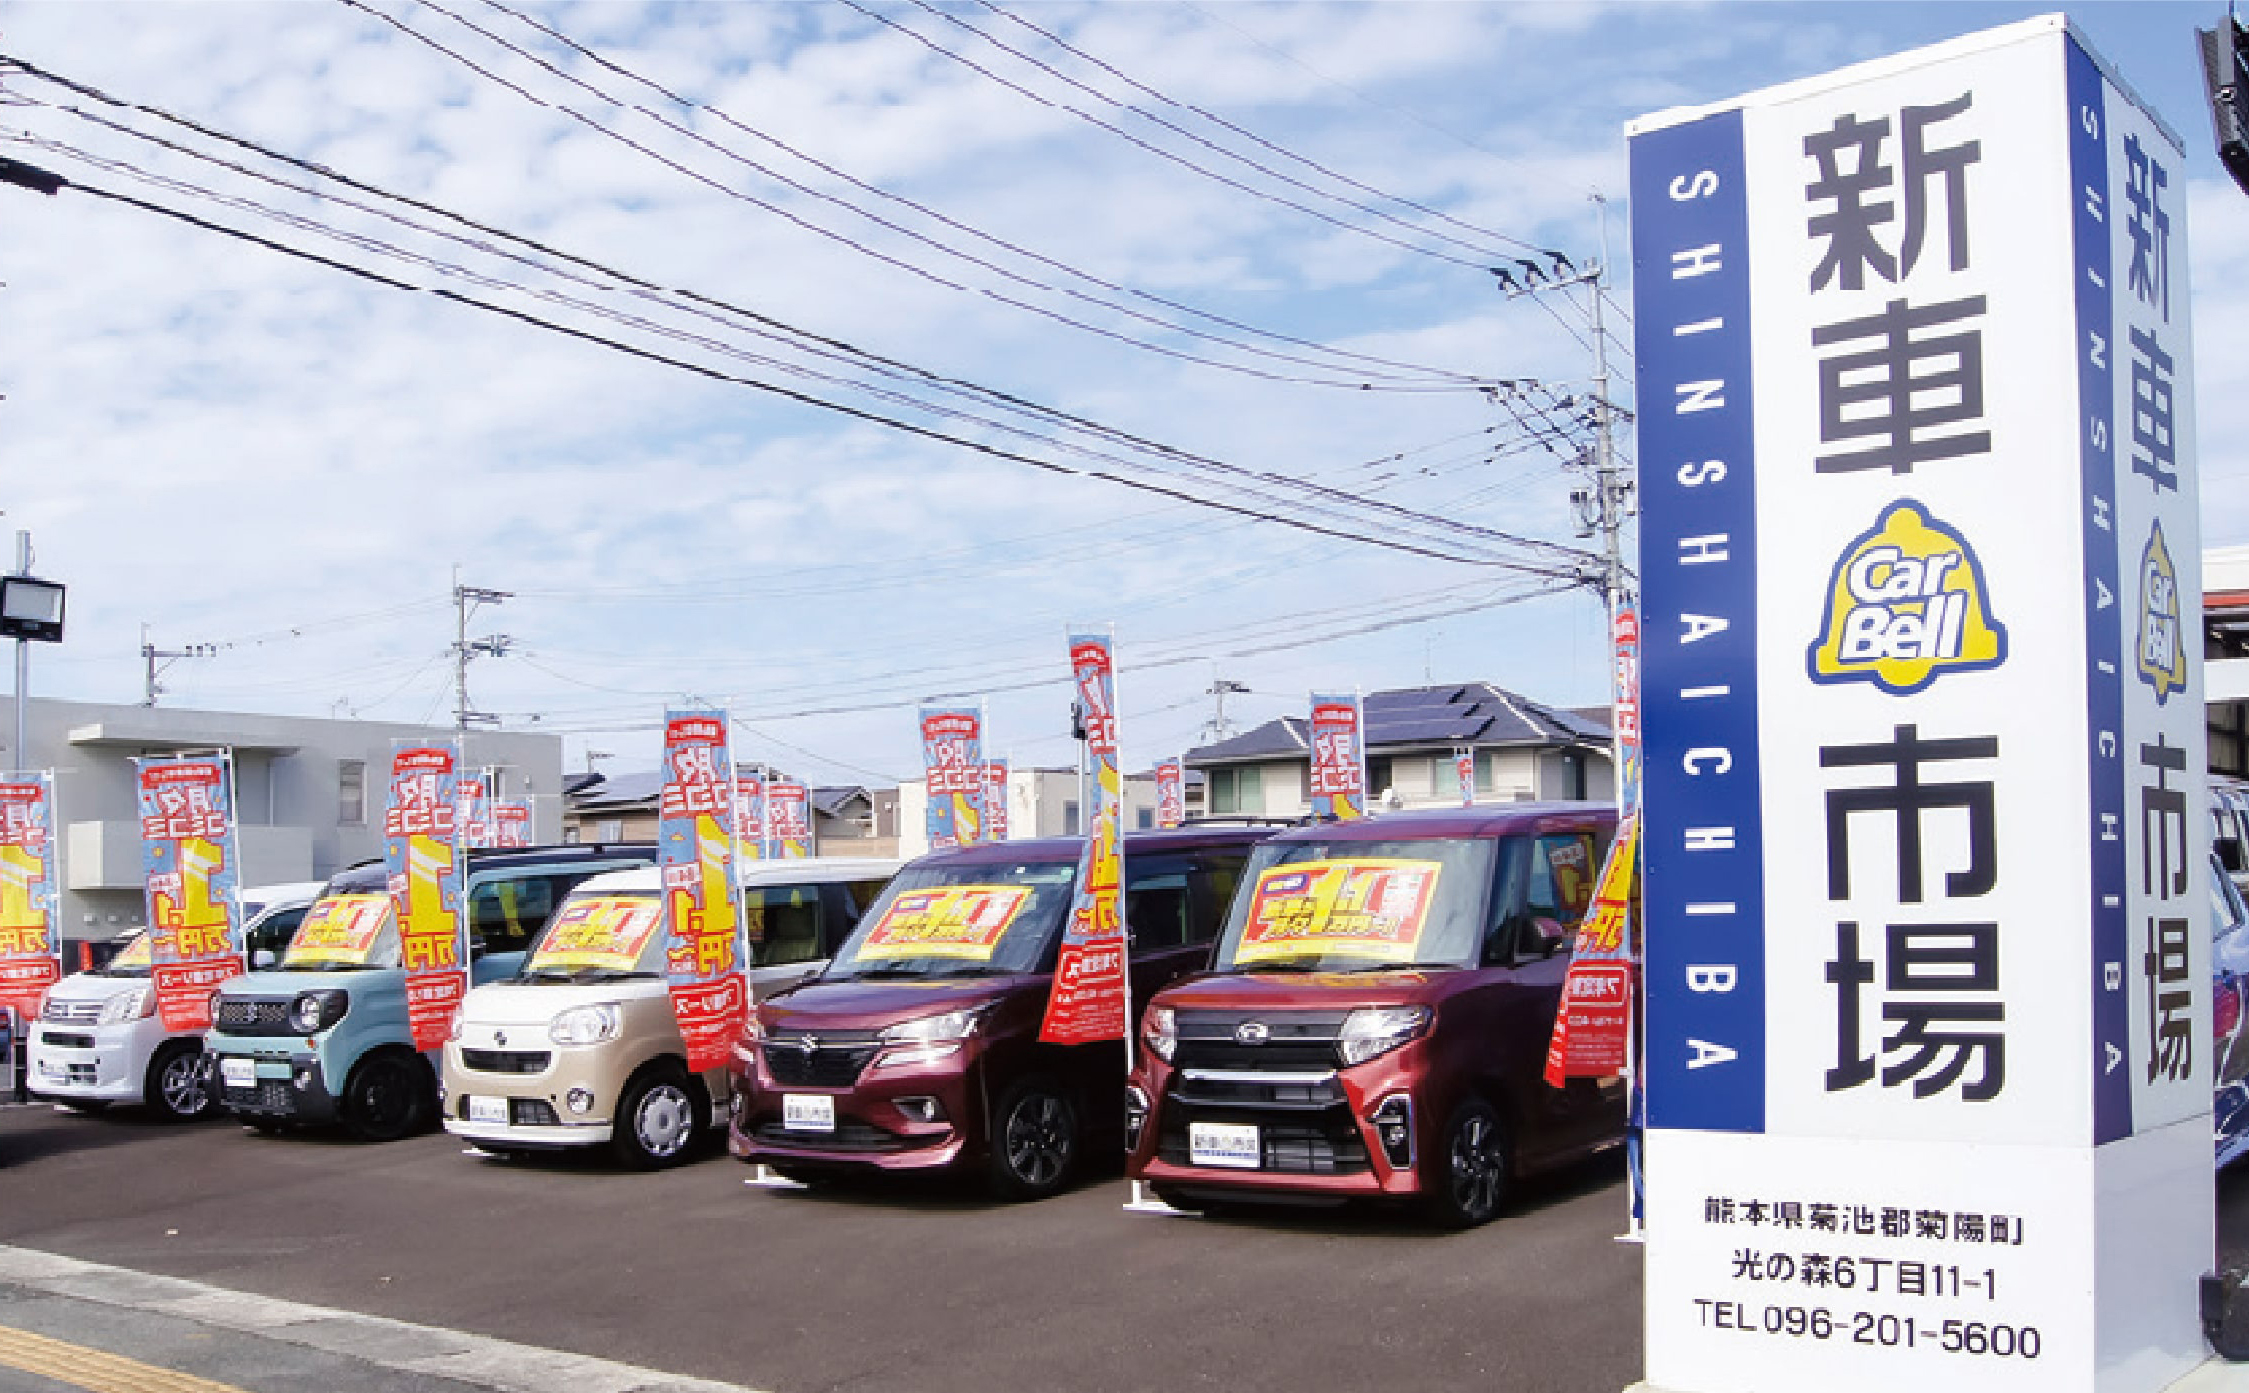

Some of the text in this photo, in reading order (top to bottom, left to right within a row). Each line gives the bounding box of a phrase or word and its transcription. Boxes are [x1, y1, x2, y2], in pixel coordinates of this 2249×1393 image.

[1802, 89, 2006, 1102] 新車 市場
[1847, 545, 1964, 602] Car
[2080, 104, 2122, 1075] SHINSHAICHIBA
[2123, 132, 2192, 1086] 新車 市場
[1669, 169, 1738, 1070] SHINSHAICHIBA
[1838, 588, 1969, 664] Bell
[1704, 1196, 2024, 1245] 熊本県菊池郡菊陽町
[1731, 1248, 1995, 1300] 光の森6丁目11-1
[1692, 1299, 2041, 1359] TEL 096-201-5600
